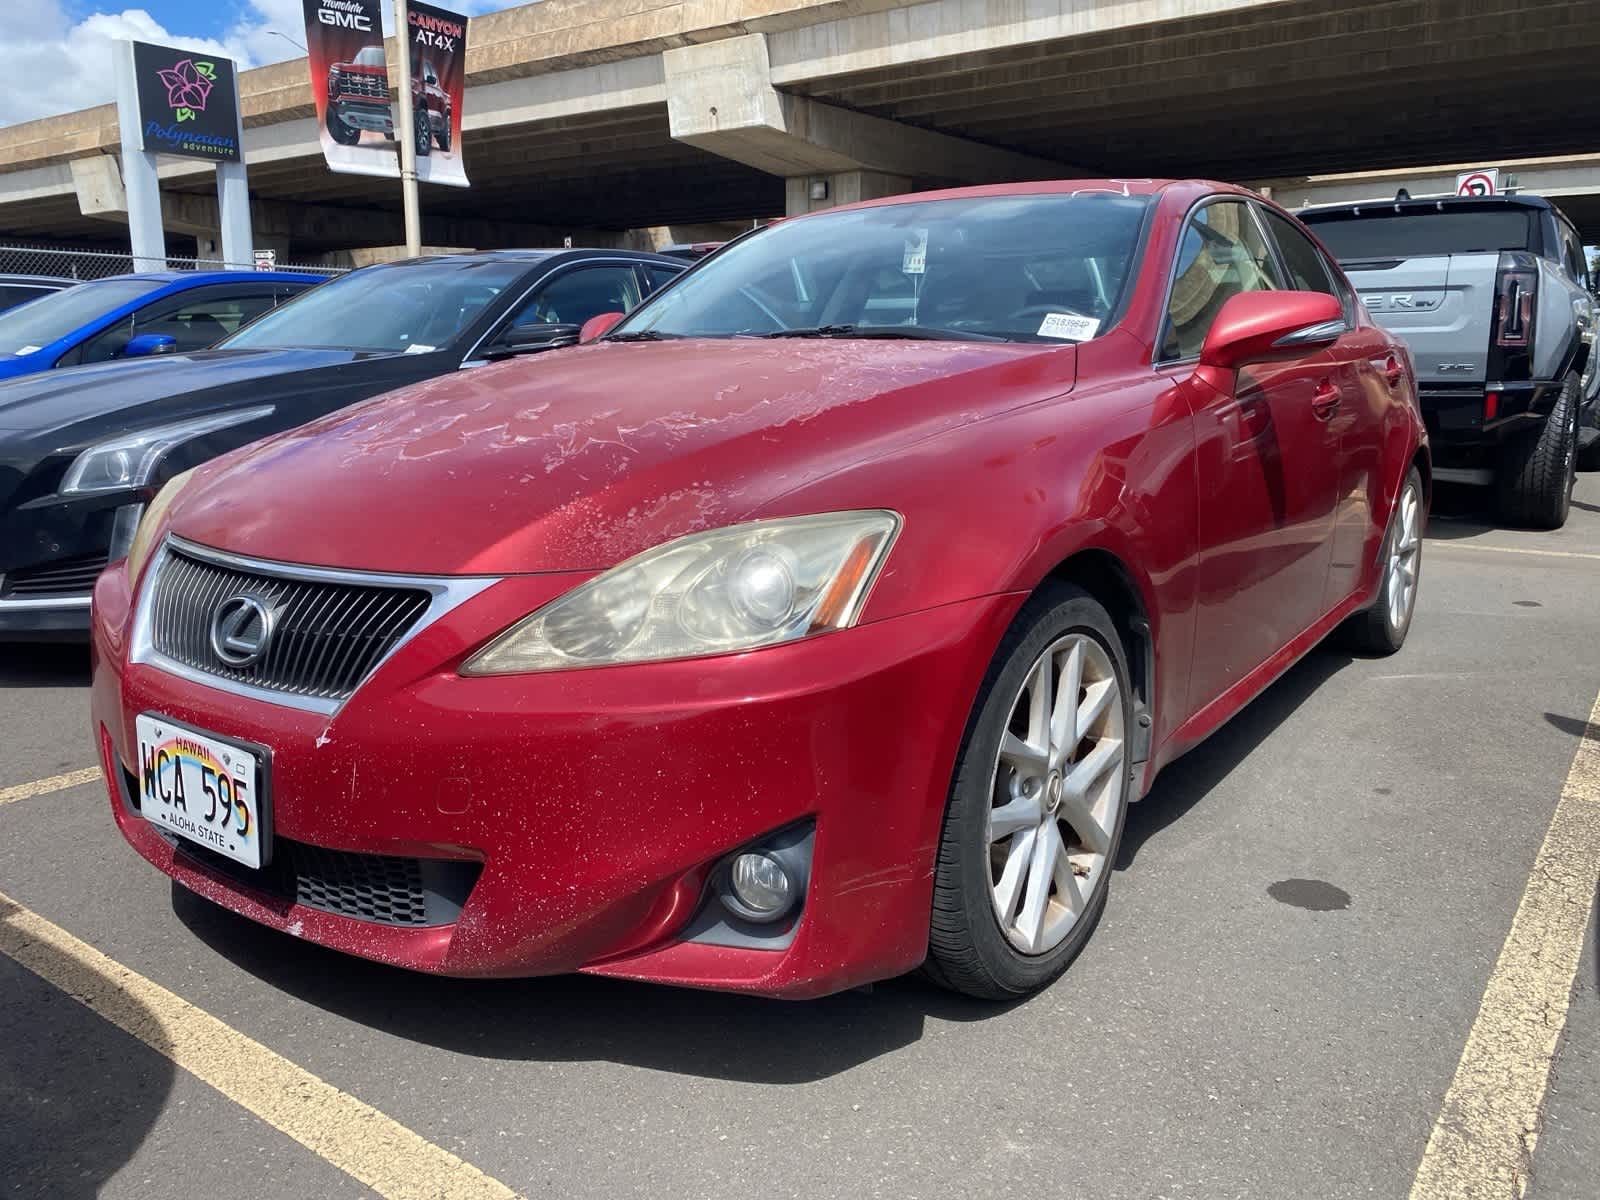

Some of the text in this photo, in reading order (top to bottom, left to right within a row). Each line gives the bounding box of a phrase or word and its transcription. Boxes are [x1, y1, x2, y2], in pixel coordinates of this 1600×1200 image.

[317, 8, 372, 33] GMC
[407, 11, 462, 39] CANYON
[415, 29, 454, 52] AT4X
[183, 142, 235, 156] adventure
[175, 736, 211, 762] HAWAII
[141, 742, 249, 837] WCA 595
[169, 812, 226, 848] ALOHA STATE
